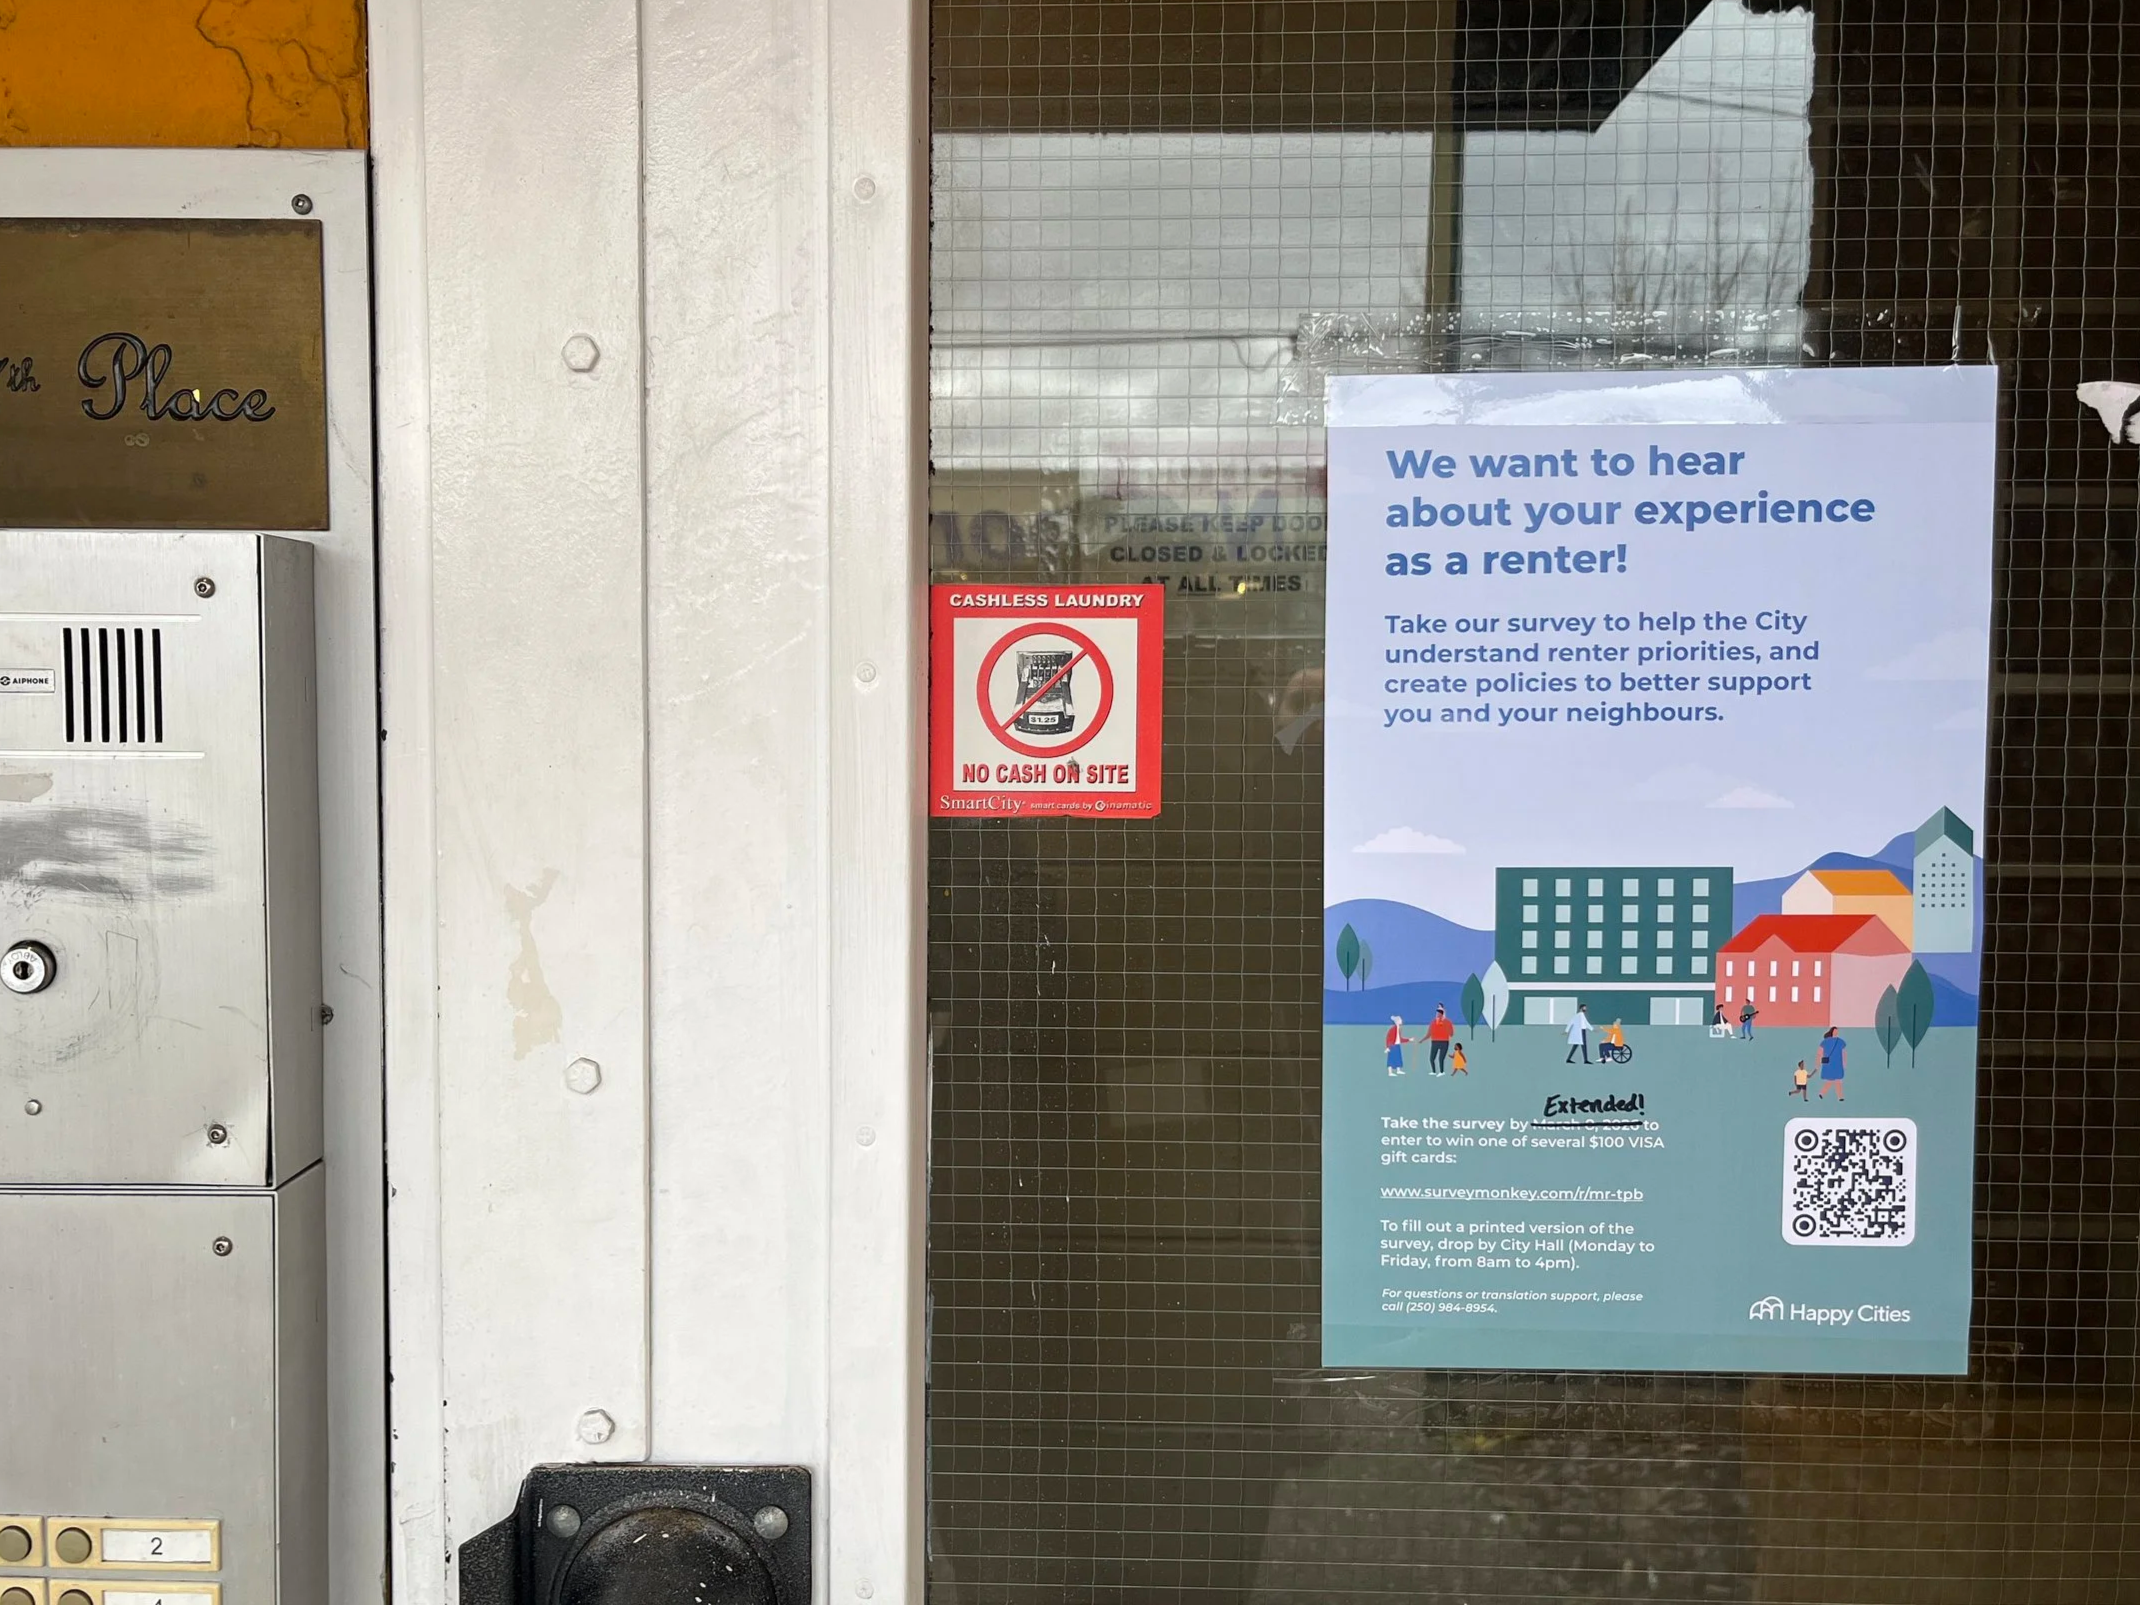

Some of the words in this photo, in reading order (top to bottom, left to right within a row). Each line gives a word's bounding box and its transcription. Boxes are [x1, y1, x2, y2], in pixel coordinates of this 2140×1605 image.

[78, 331, 276, 421] Place
[1386, 450, 1456, 479] We
[1469, 449, 1578, 477] want
[1591, 449, 1634, 476] to
[1650, 445, 1745, 475] hear
[1386, 497, 1511, 527] about
[1524, 502, 1621, 533] your
[1635, 490, 1875, 531] experience
[1104, 516, 1194, 532] PLEASE
[1202, 516, 1263, 532] KEEP
[1272, 516, 1327, 532] DOO
[1110, 546, 1203, 562] CLOSED
[1386, 553, 1431, 576] as
[1445, 552, 1467, 575] a
[1484, 544, 1626, 574] renter!
[1177, 576, 1221, 592] ALL
[950, 594, 1049, 608] CASHLESS
[1054, 594, 1144, 607] LAUNDRY
[1385, 614, 1447, 633] Take
[1455, 618, 1499, 633] our
[1508, 617, 1596, 636] survey
[1603, 614, 1630, 631] to
[1639, 611, 1695, 635] help
[1703, 611, 1747, 630] the
[1756, 610, 1807, 634] City
[1386, 643, 1538, 663] understand
[1549, 644, 1629, 661] renter
[1638, 640, 1761, 665] priorities,
[1770, 641, 1818, 660] and
[12, 677, 49, 685] AIPHONE
[1385, 676, 1467, 693] create
[1477, 672, 1577, 697] policies
[1585, 675, 1611, 691] to
[1621, 672, 1700, 691] better
[1708, 673, 1811, 695] support
[1384, 709, 1431, 727] you
[1441, 703, 1489, 722] and
[1499, 708, 1558, 726] your
[1567, 701, 1723, 726] neighbours.
[962, 763, 989, 782] NO
[996, 764, 1046, 783] CASH
[1053, 764, 1080, 783] ON
[1087, 765, 1129, 783] SITE
[1082, 802, 1094, 811] by
[1543, 1093, 1645, 1117] Extended!
[1381, 1117, 1418, 1128] Take
[1422, 1117, 1449, 1129] the
[1453, 1120, 1505, 1132] survey
[1510, 1118, 1528, 1132] by
[1640, 1120, 1659, 1130] to
[1381, 1135, 1422, 1145] enter
[1426, 1135, 1442, 1146] to
[1446, 1134, 1473, 1146] win
[1479, 1138, 1508, 1146] one
[1512, 1135, 1528, 1147] of
[1531, 1136, 1584, 1147] several
[1590, 1135, 1624, 1149] $100
[1628, 1137, 1664, 1148] VISA
[1381, 1151, 1407, 1165] gift
[1412, 1151, 1456, 1163] cards:
[1380, 1185, 1644, 1201] www.surveymonkey.com/r/mr-tpb
[1380, 1220, 1398, 1231] To
[1402, 1219, 1421, 1231] fill
[1426, 1222, 1451, 1232] out
[1456, 1223, 1464, 1232] a
[1470, 1221, 1524, 1235] printed
[1529, 1222, 1584, 1233] version
[1589, 1222, 1605, 1234] of
[1608, 1223, 1634, 1234] the
[1381, 1240, 1433, 1252] survey,
[1438, 1238, 1474, 1252] drop
[1479, 1238, 1496, 1253] by
[1501, 1238, 1530, 1253] City
[1535, 1239, 1563, 1251] Hall
[1569, 1240, 1635, 1254] (Monday
[1639, 1241, 1654, 1252] to
[1381, 1254, 1430, 1269] Friday,
[1435, 1255, 1472, 1267] from
[1477, 1256, 1510, 1267] 8am
[1515, 1257, 1530, 1268] to
[1535, 1257, 1579, 1271] 4pm).
[1382, 1289, 1402, 1297] For
[1404, 1289, 1462, 1300] questions
[1482, 1290, 1547, 1300] translation
[1551, 1292, 1599, 1302] support,
[1603, 1292, 1643, 1302] please
[1382, 1302, 1403, 1311] call
[1406, 1302, 1435, 1313] (250)
[1438, 1303, 1497, 1312] 984-8954.
[1791, 1304, 1853, 1325] Happy
[1858, 1305, 1910, 1322] Cities
[151, 1537, 163, 1555] 2
